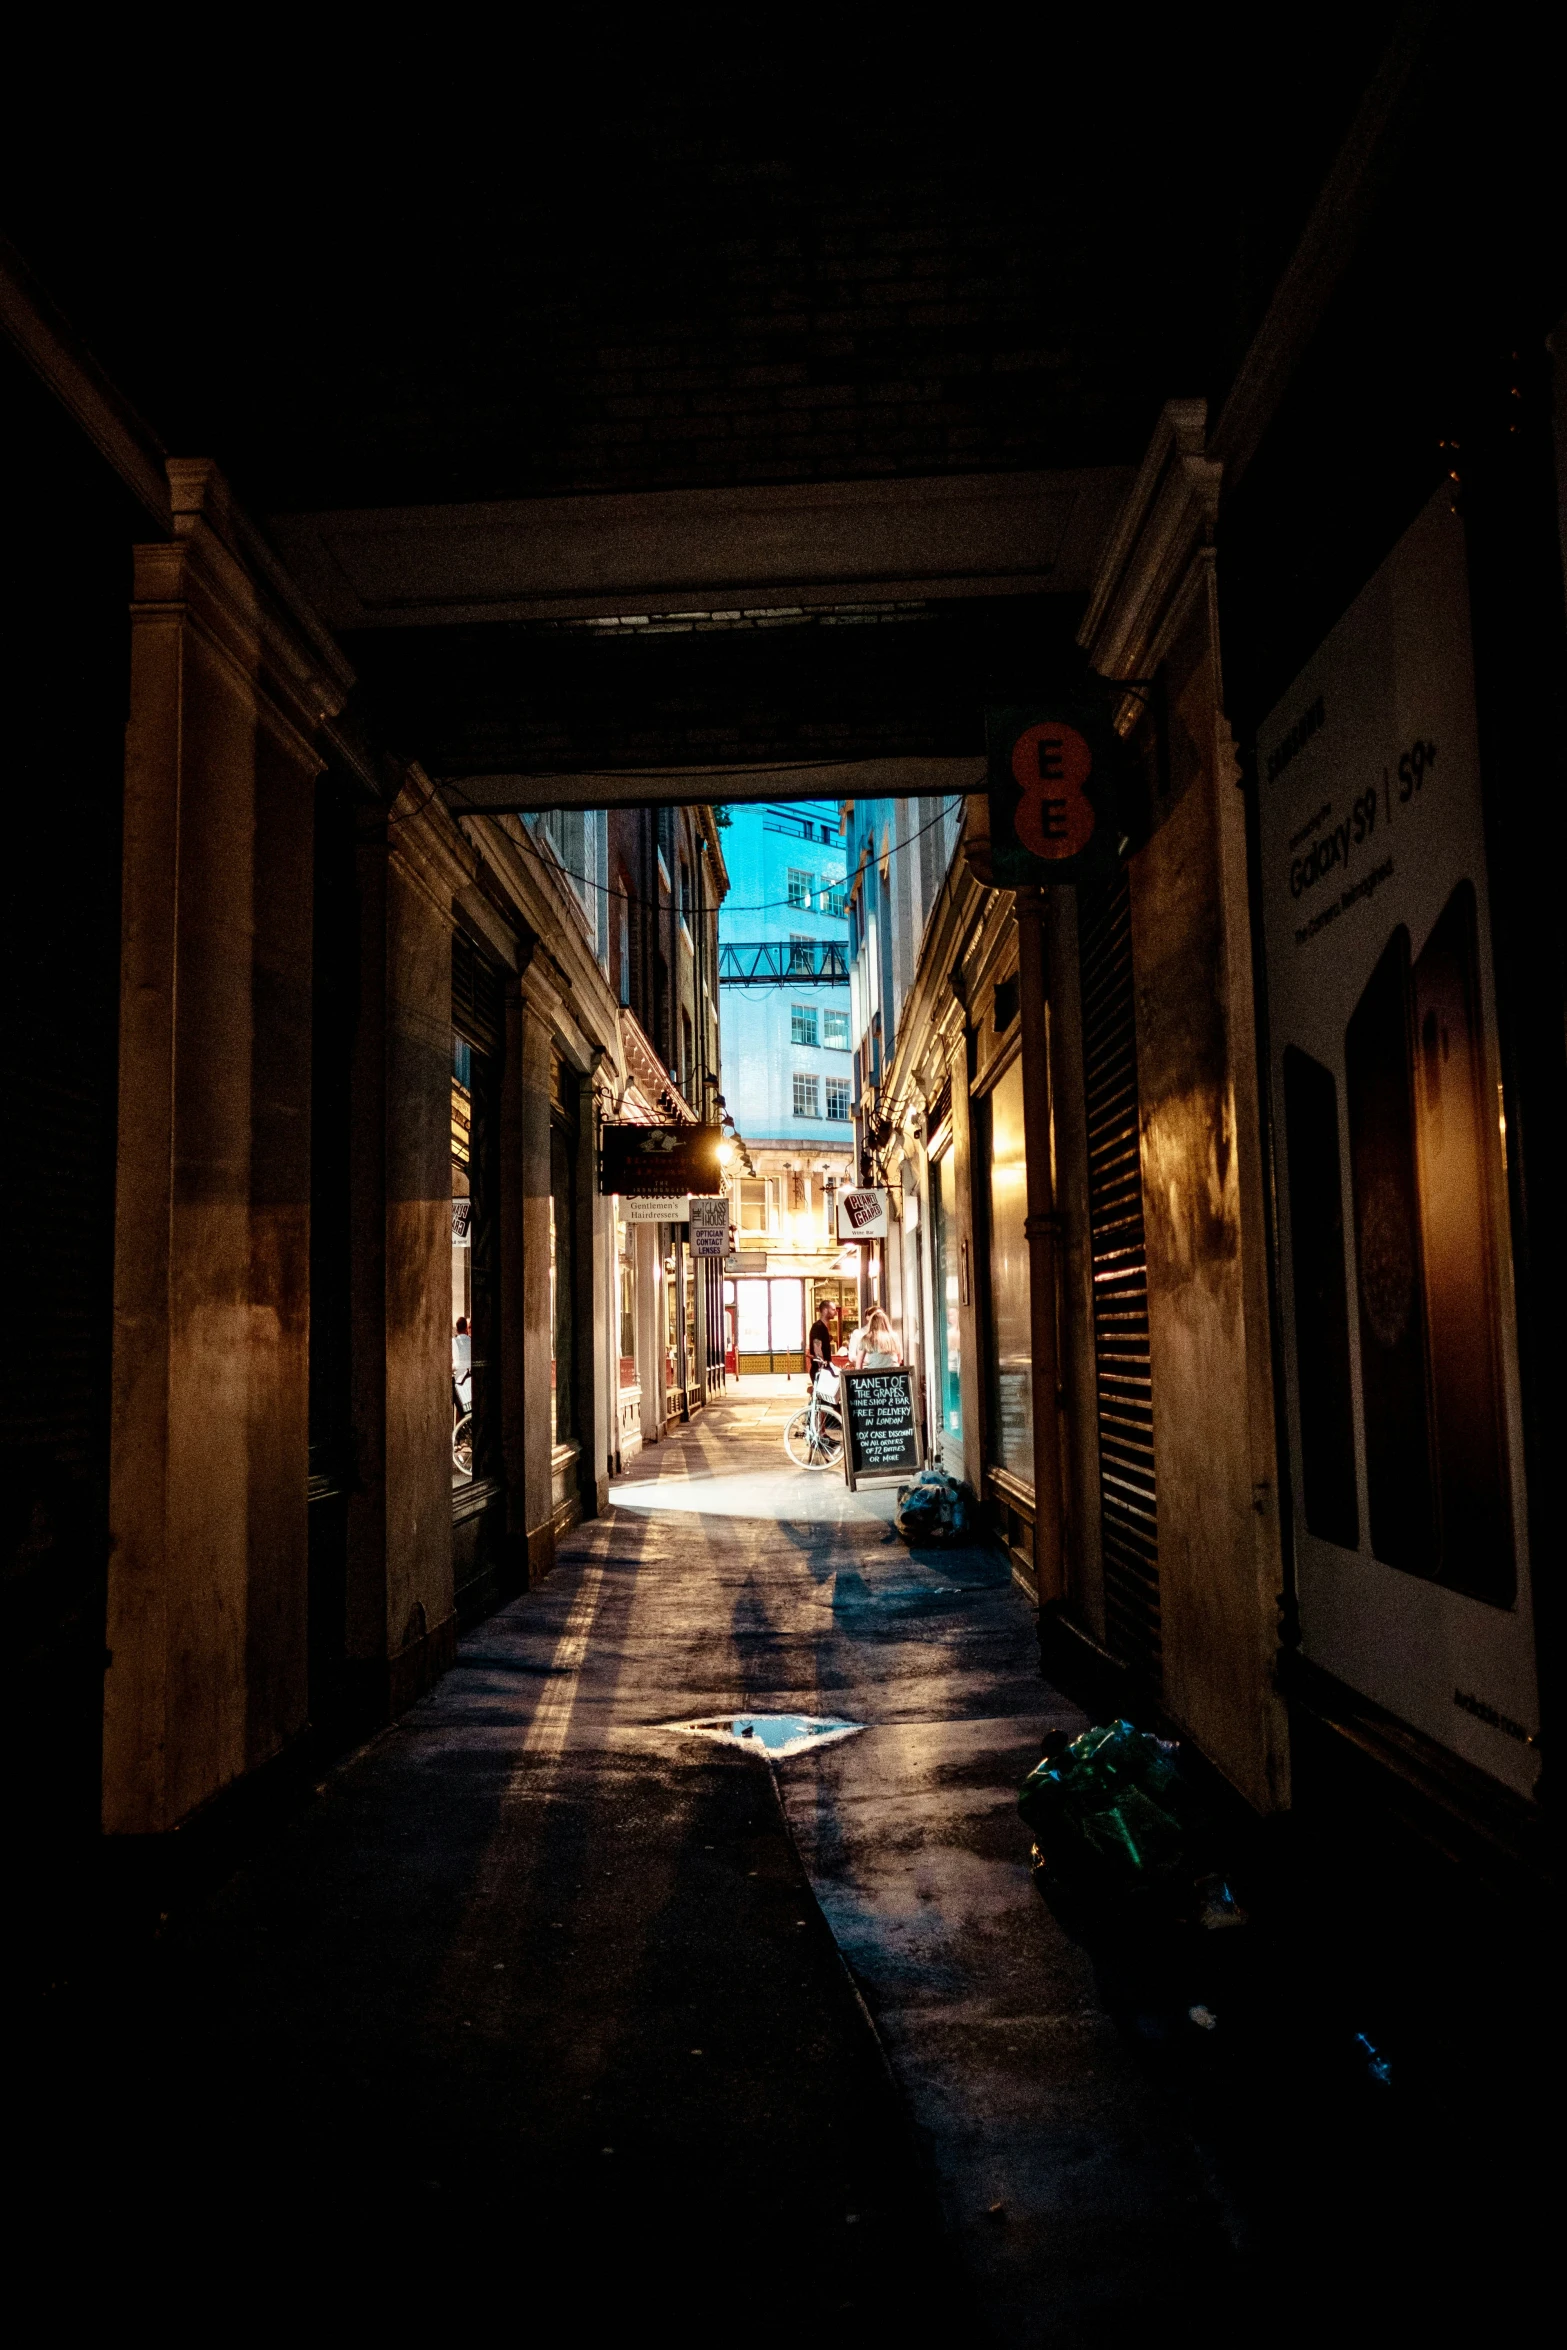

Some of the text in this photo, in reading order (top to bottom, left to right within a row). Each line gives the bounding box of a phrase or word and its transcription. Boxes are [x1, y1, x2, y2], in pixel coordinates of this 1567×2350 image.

[1290, 816, 1351, 898] Galaxy
[1354, 787, 1376, 844] S9
[1399, 740, 1437, 802] S9+
[630, 1202, 679, 1210] Gentlemen's
[850, 1194, 878, 1209] PLANET
[704, 1202, 726, 1214] GLASS
[631, 1211, 679, 1219] Hairdressers
[693, 1208, 702, 1222] THE
[705, 1213, 726, 1226] HOUSE
[855, 1205, 881, 1226] GRAPES
[696, 1238, 722, 1246] CONTACT
[698, 1246, 721, 1255] LENSES
[850, 1375, 908, 1389] PLANET OF
[854, 1387, 905, 1398] THE GRAPES
[869, 1398, 887, 1406] SHOP
[895, 1397, 910, 1405] BAR
[853, 1406, 910, 1417] FREE DELIVERY
[865, 1416, 904, 1426] IN LONDON
[870, 1430, 887, 1438] CASE
[888, 1428, 913, 1438] DISCOUNT
[880, 1438, 904, 1446] ORDERS
[874, 1446, 882, 1454] 12
[883, 1454, 899, 1462] MORE
